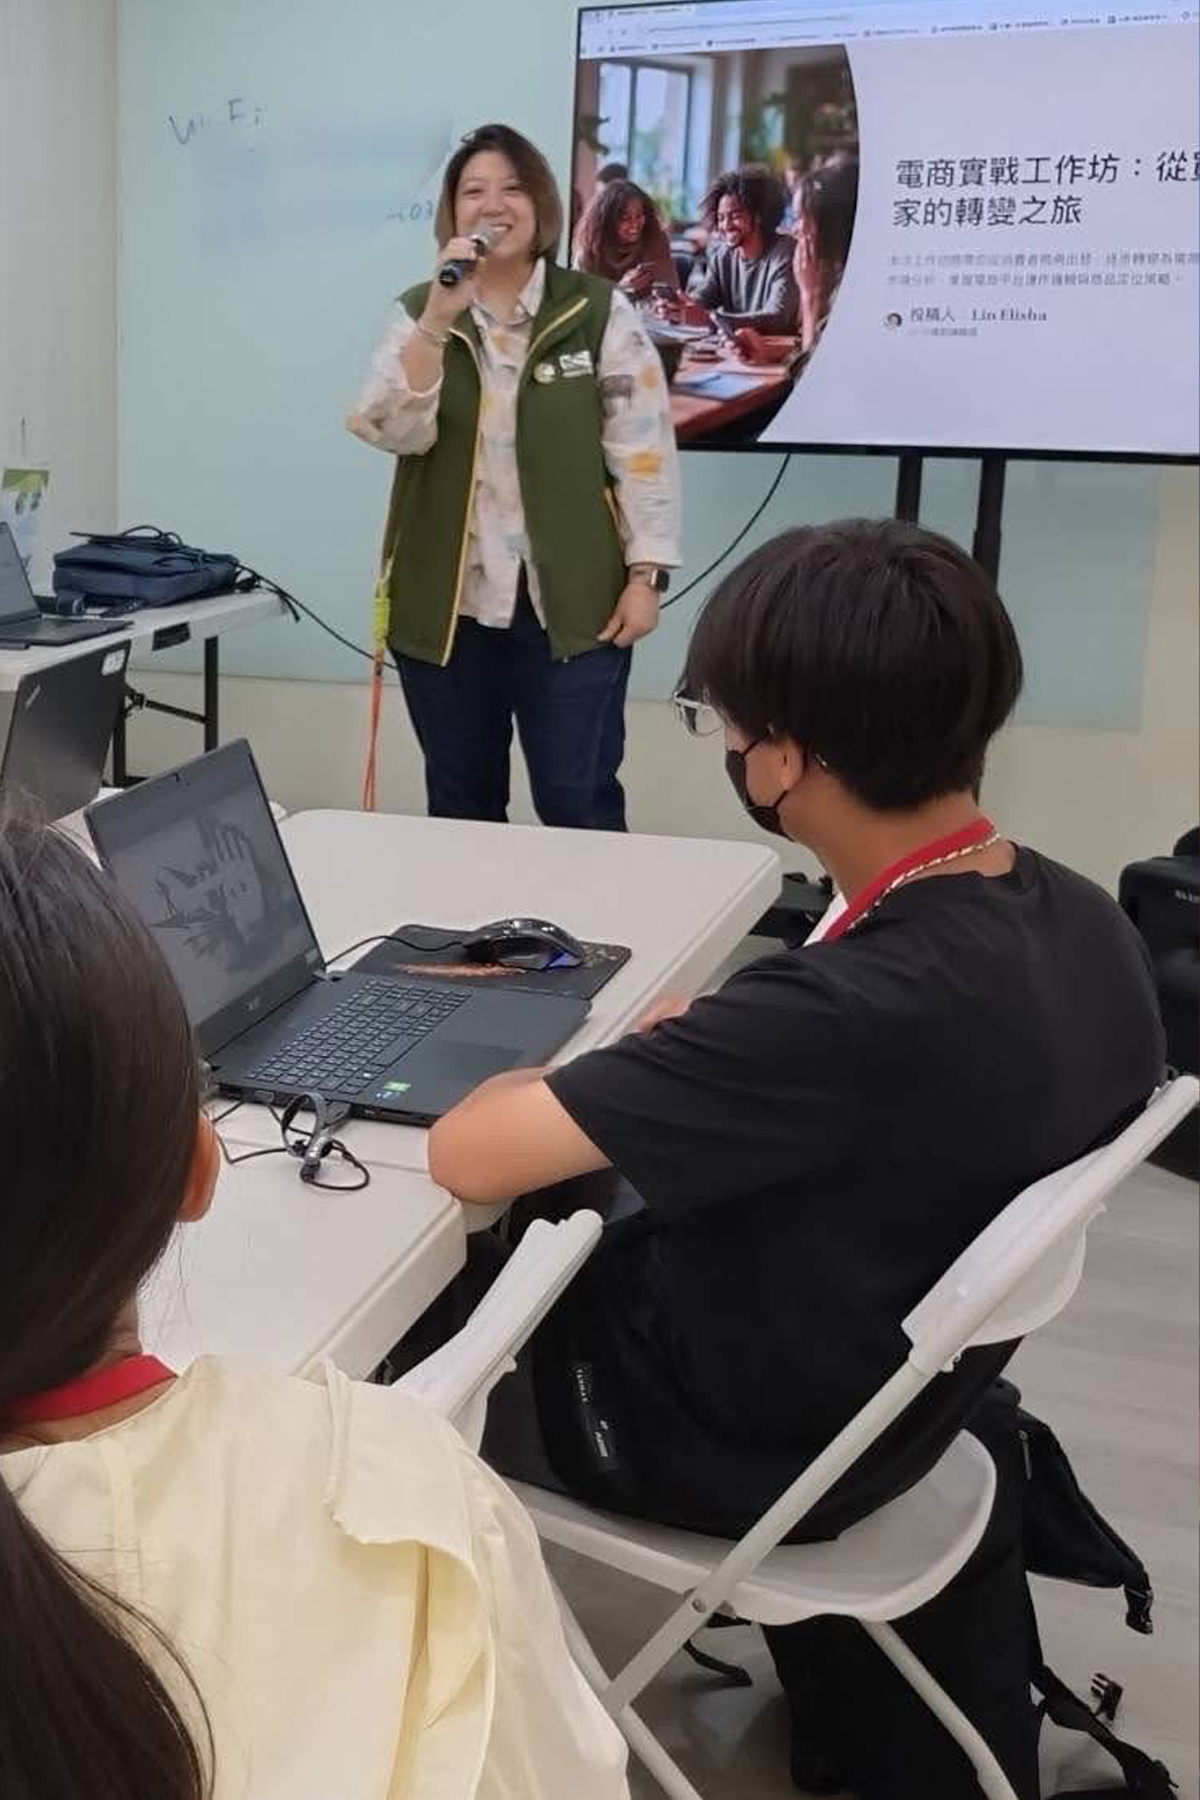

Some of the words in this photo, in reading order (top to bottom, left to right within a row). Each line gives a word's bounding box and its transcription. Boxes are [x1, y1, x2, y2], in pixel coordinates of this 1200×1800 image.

[893, 195, 1082, 227] 家的轉變之旅
[971, 309, 996, 322] Lin
[999, 307, 1048, 322] Elisha
